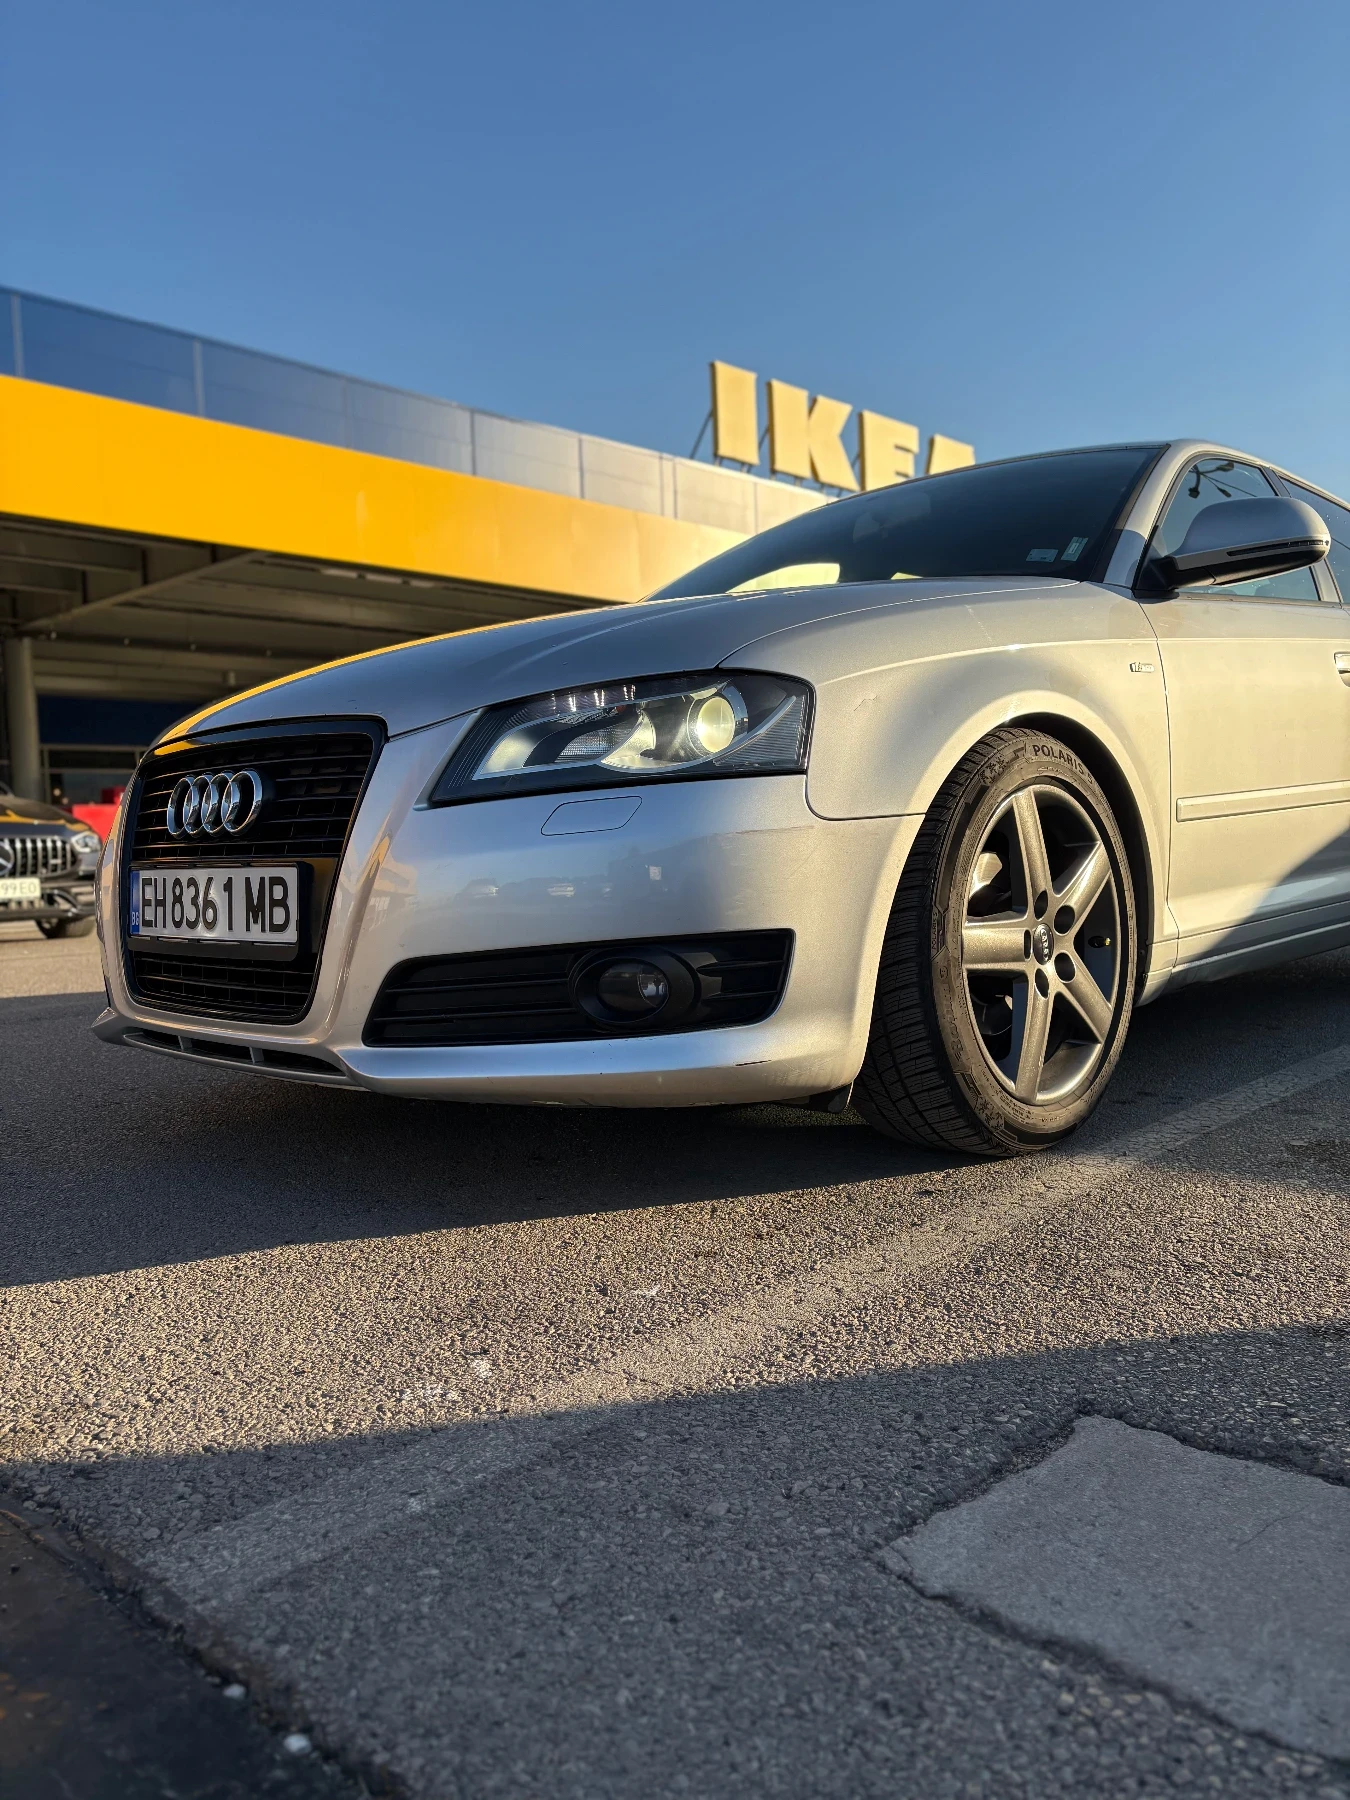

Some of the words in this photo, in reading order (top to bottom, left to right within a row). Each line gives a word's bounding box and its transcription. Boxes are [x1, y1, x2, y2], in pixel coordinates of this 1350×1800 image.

[1032, 744, 1084, 774] POLARIS
[141, 877, 167, 928] EH
[171, 877, 233, 931] 8361
[245, 876, 290, 933] MB
